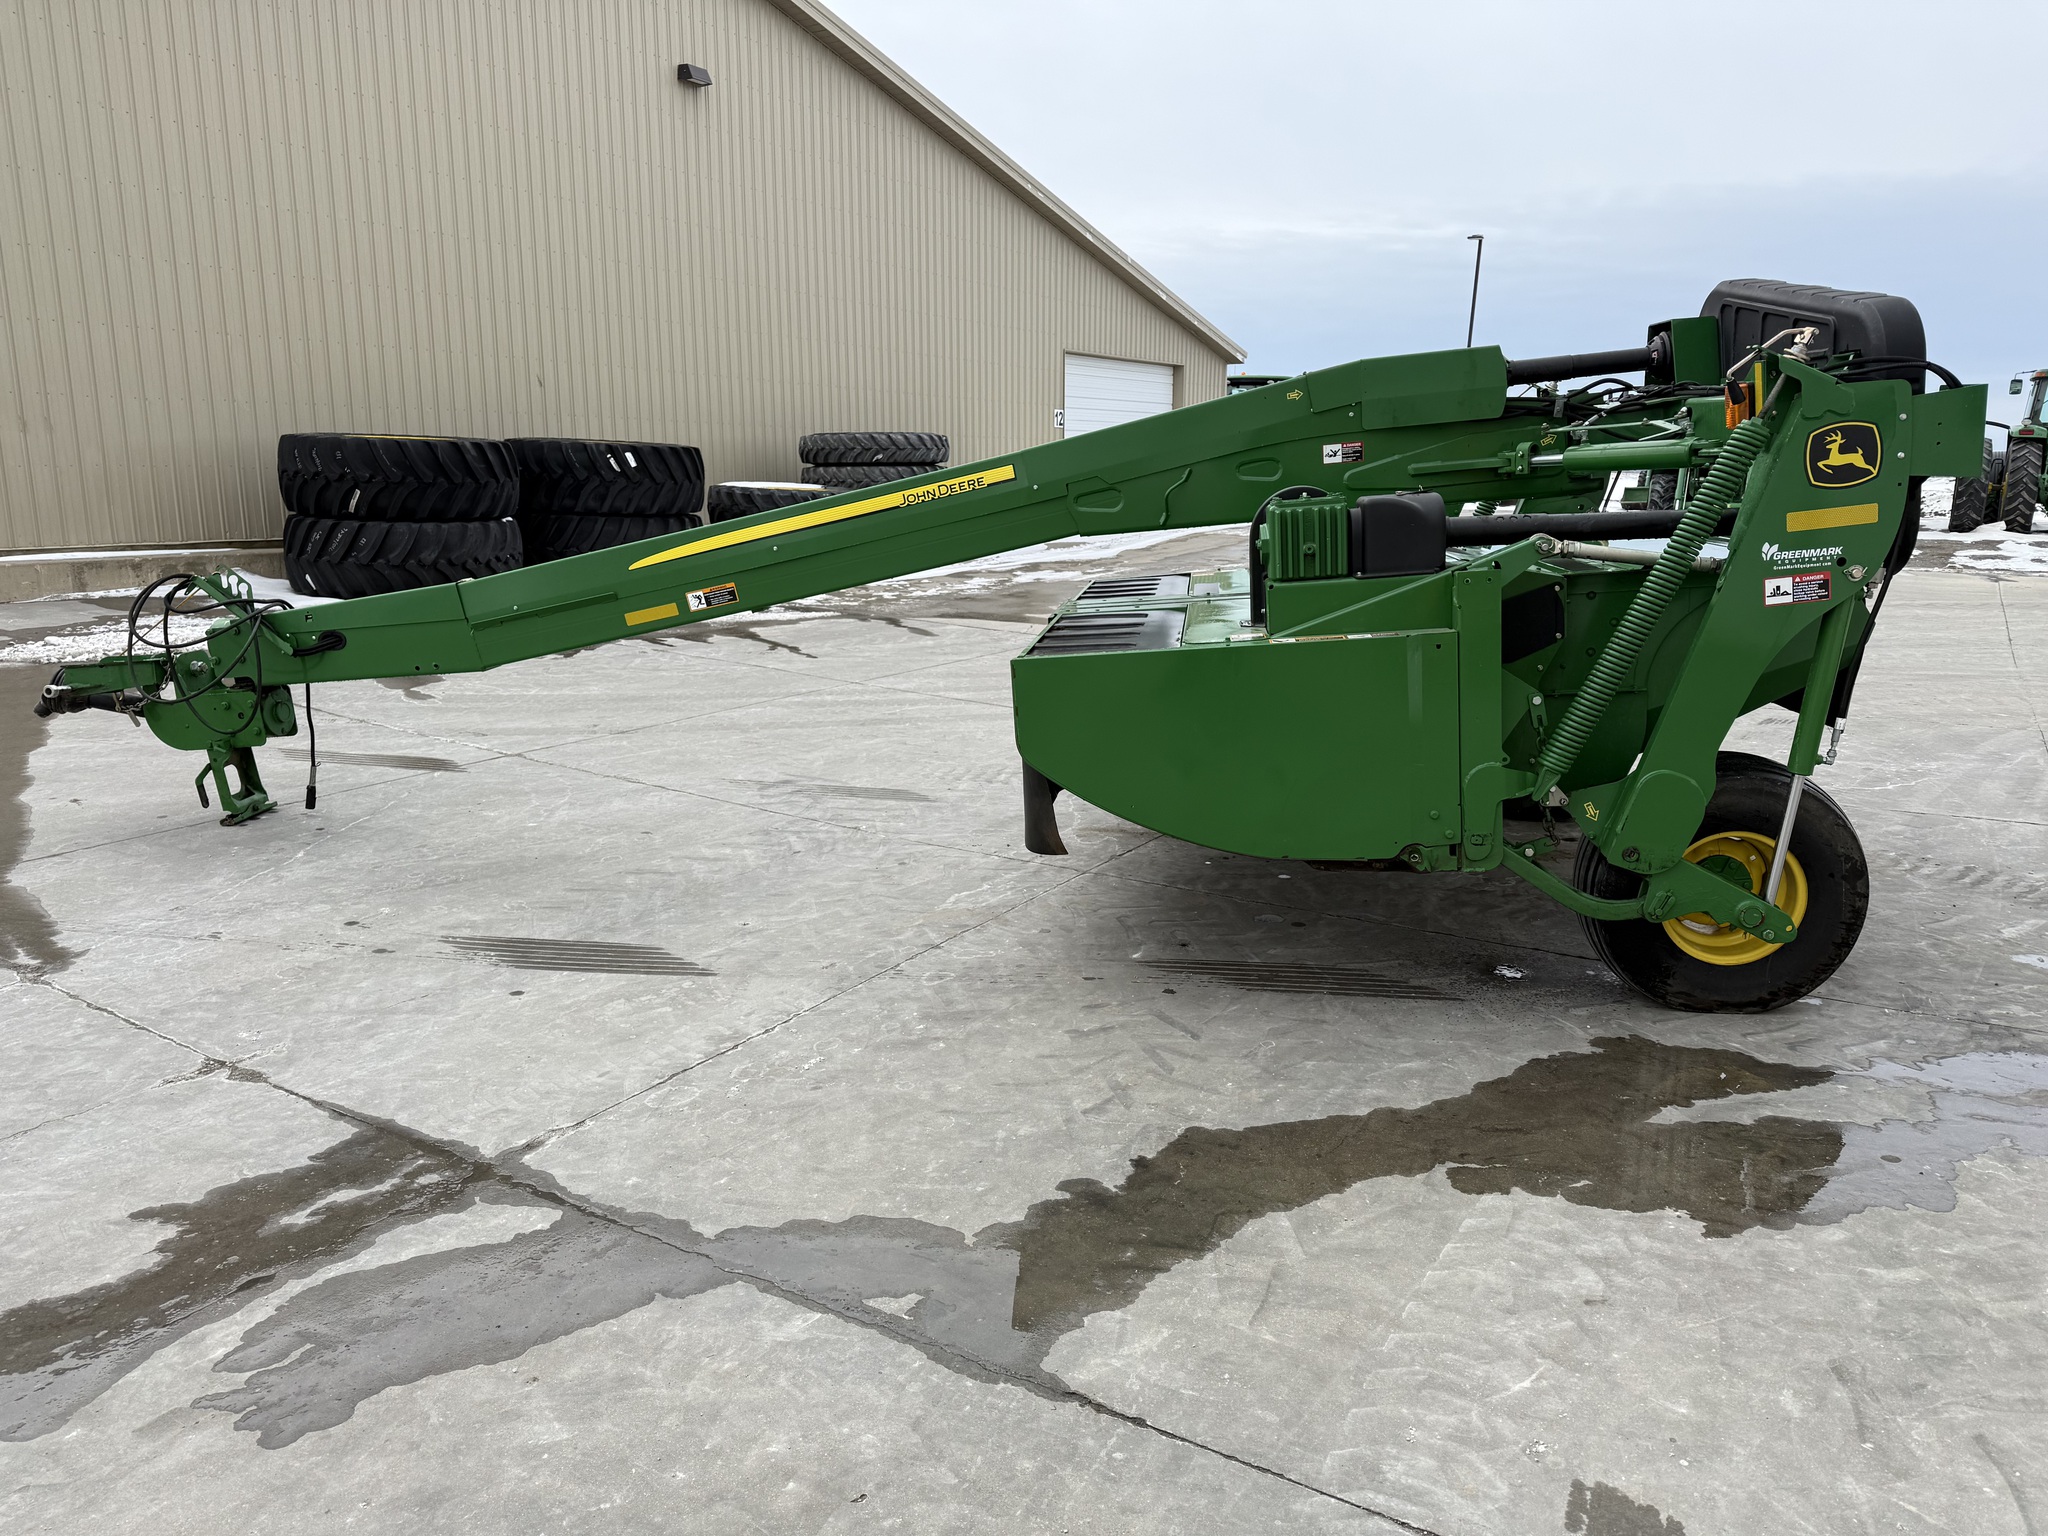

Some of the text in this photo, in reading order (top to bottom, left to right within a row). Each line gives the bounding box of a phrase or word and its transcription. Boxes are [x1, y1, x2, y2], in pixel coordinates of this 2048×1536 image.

[1055, 411, 1063, 426] 12
[900, 477, 986, 505] JOHN DEERE
[1773, 546, 1843, 560] GREENMARK
[1778, 556, 1837, 564] EQUIPMENT
